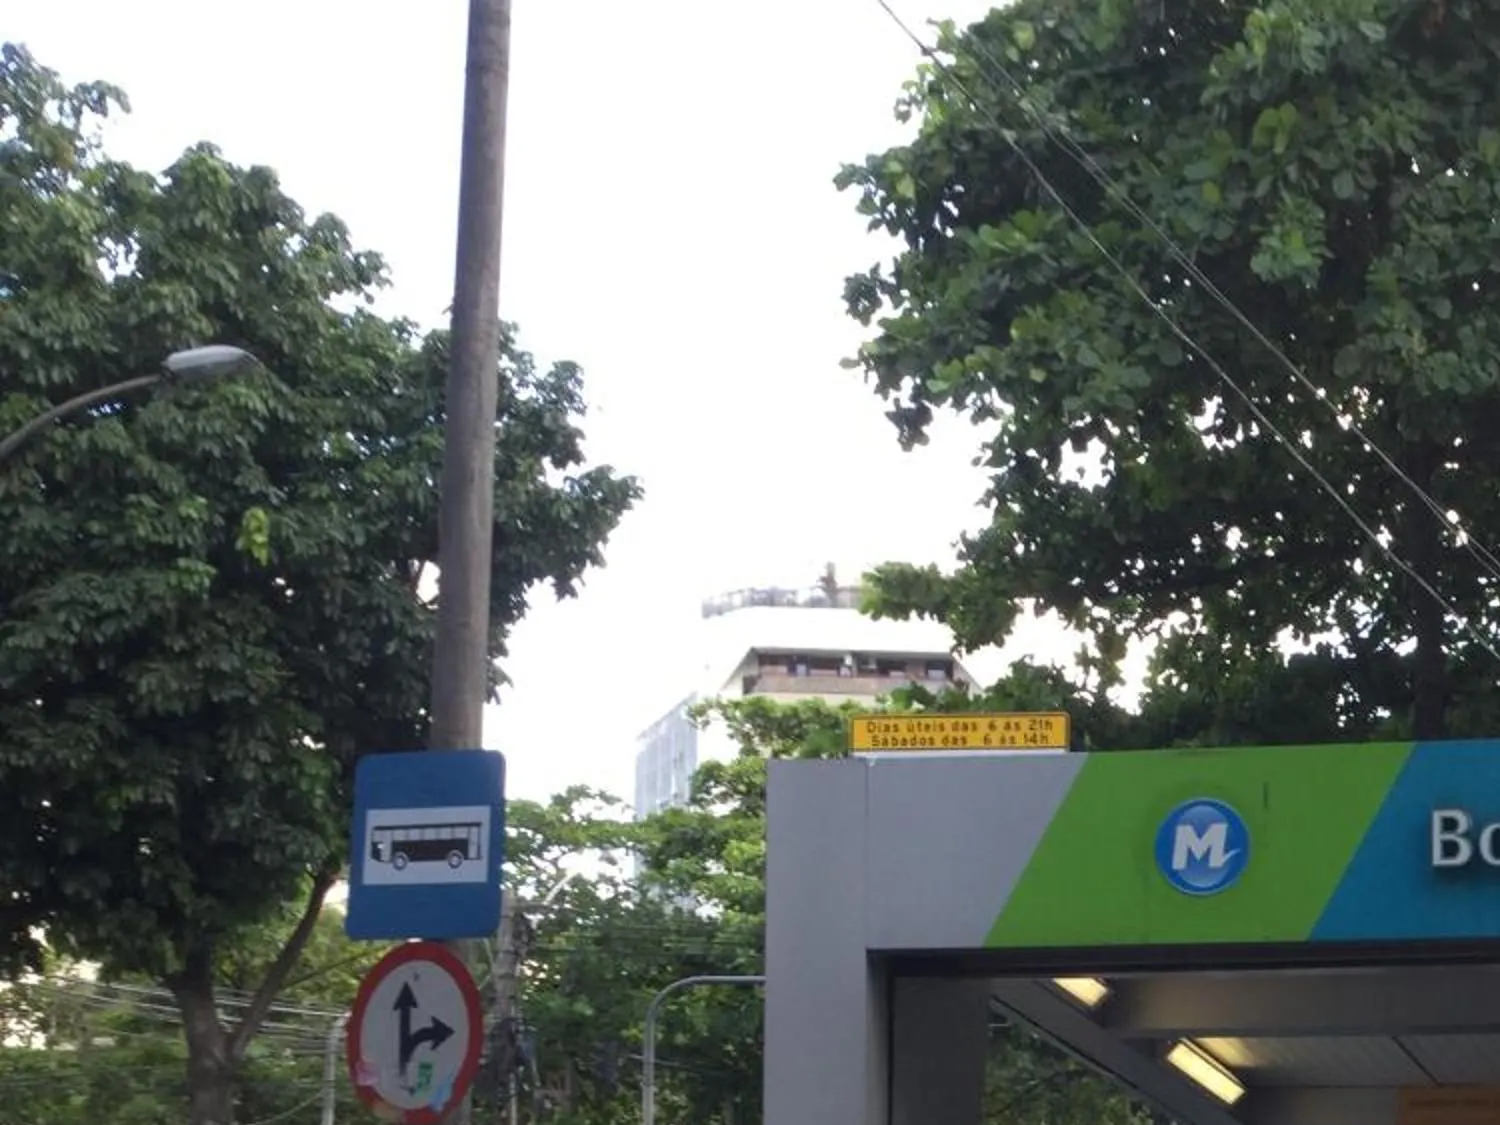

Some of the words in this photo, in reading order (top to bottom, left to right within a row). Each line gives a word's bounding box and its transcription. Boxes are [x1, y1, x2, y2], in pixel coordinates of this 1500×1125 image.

[867, 720, 900, 733] Dias
[906, 719, 945, 732] úteis
[951, 719, 978, 732] das
[987, 719, 997, 732] 6
[1028, 718, 1054, 732] 21h
[942, 733, 969, 746] das
[983, 732, 993, 745] 6
